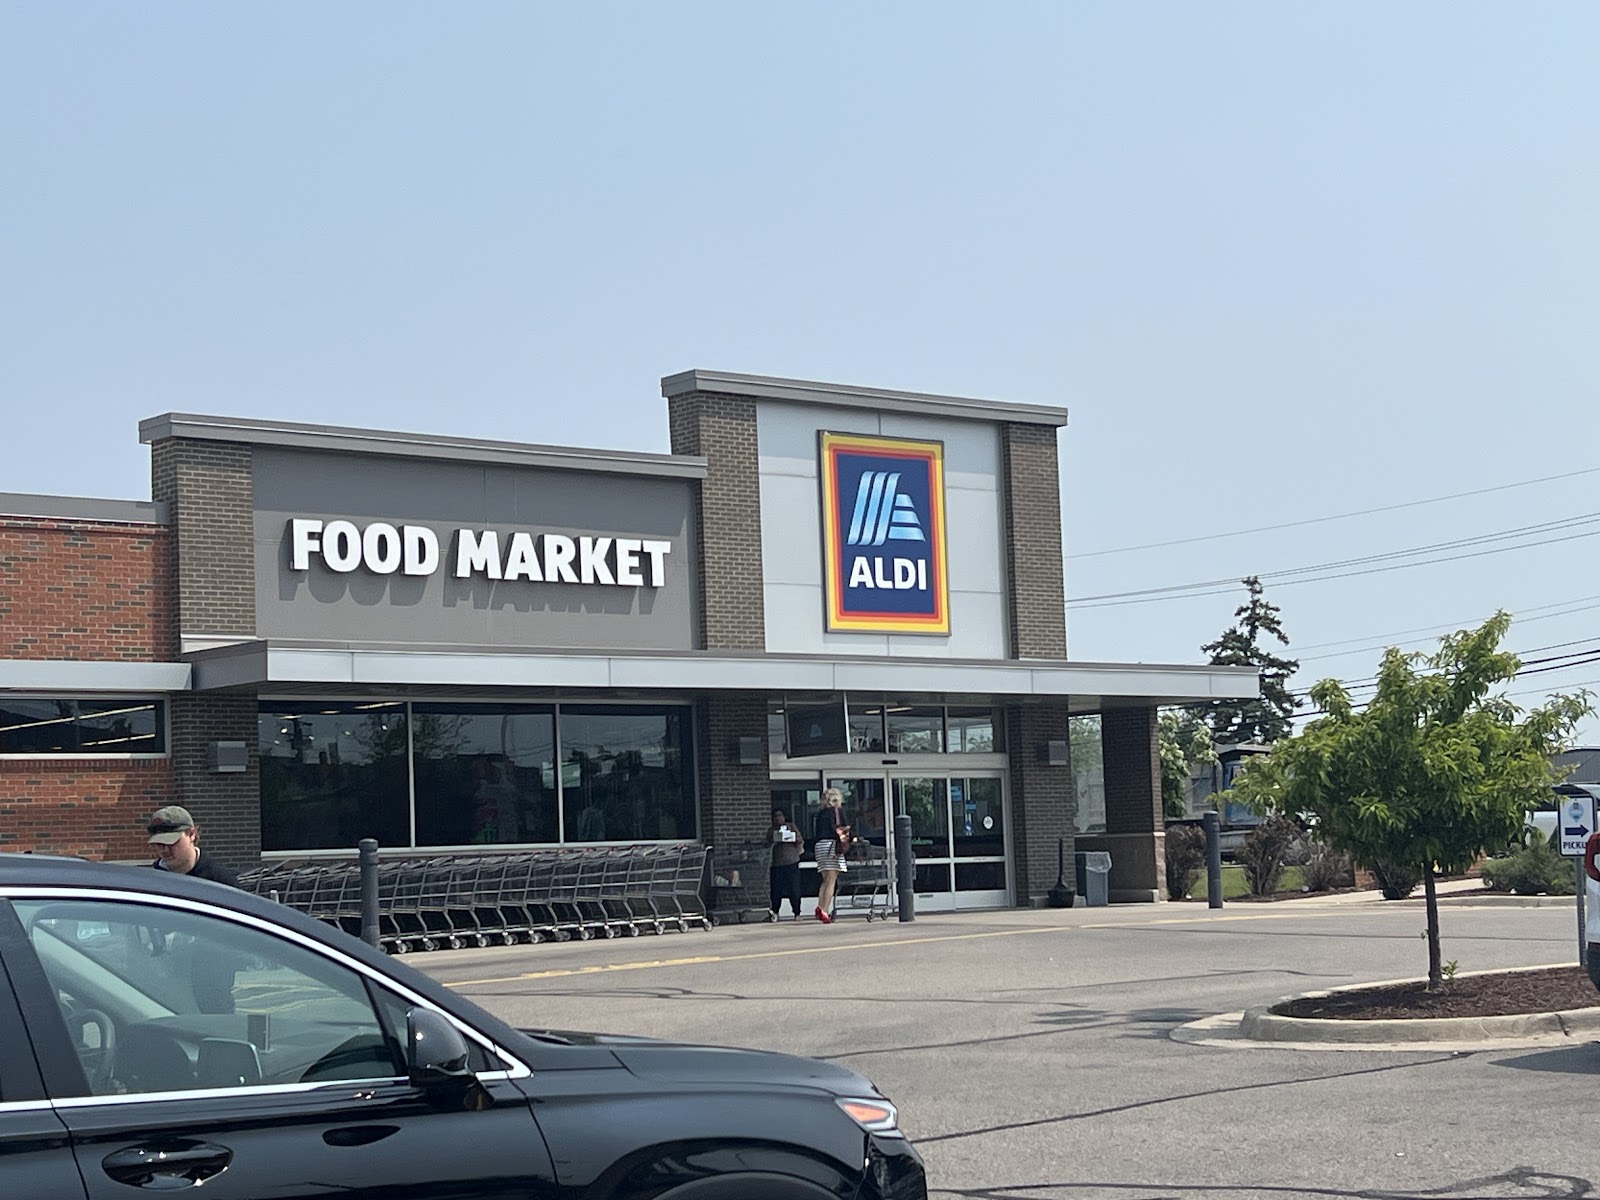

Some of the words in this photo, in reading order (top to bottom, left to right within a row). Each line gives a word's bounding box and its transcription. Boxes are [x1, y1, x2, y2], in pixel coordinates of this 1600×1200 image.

[291, 518, 440, 576] FOOD
[455, 528, 672, 587] MARKET
[849, 556, 927, 590] ALDI
[1563, 841, 1587, 849] PICKU
